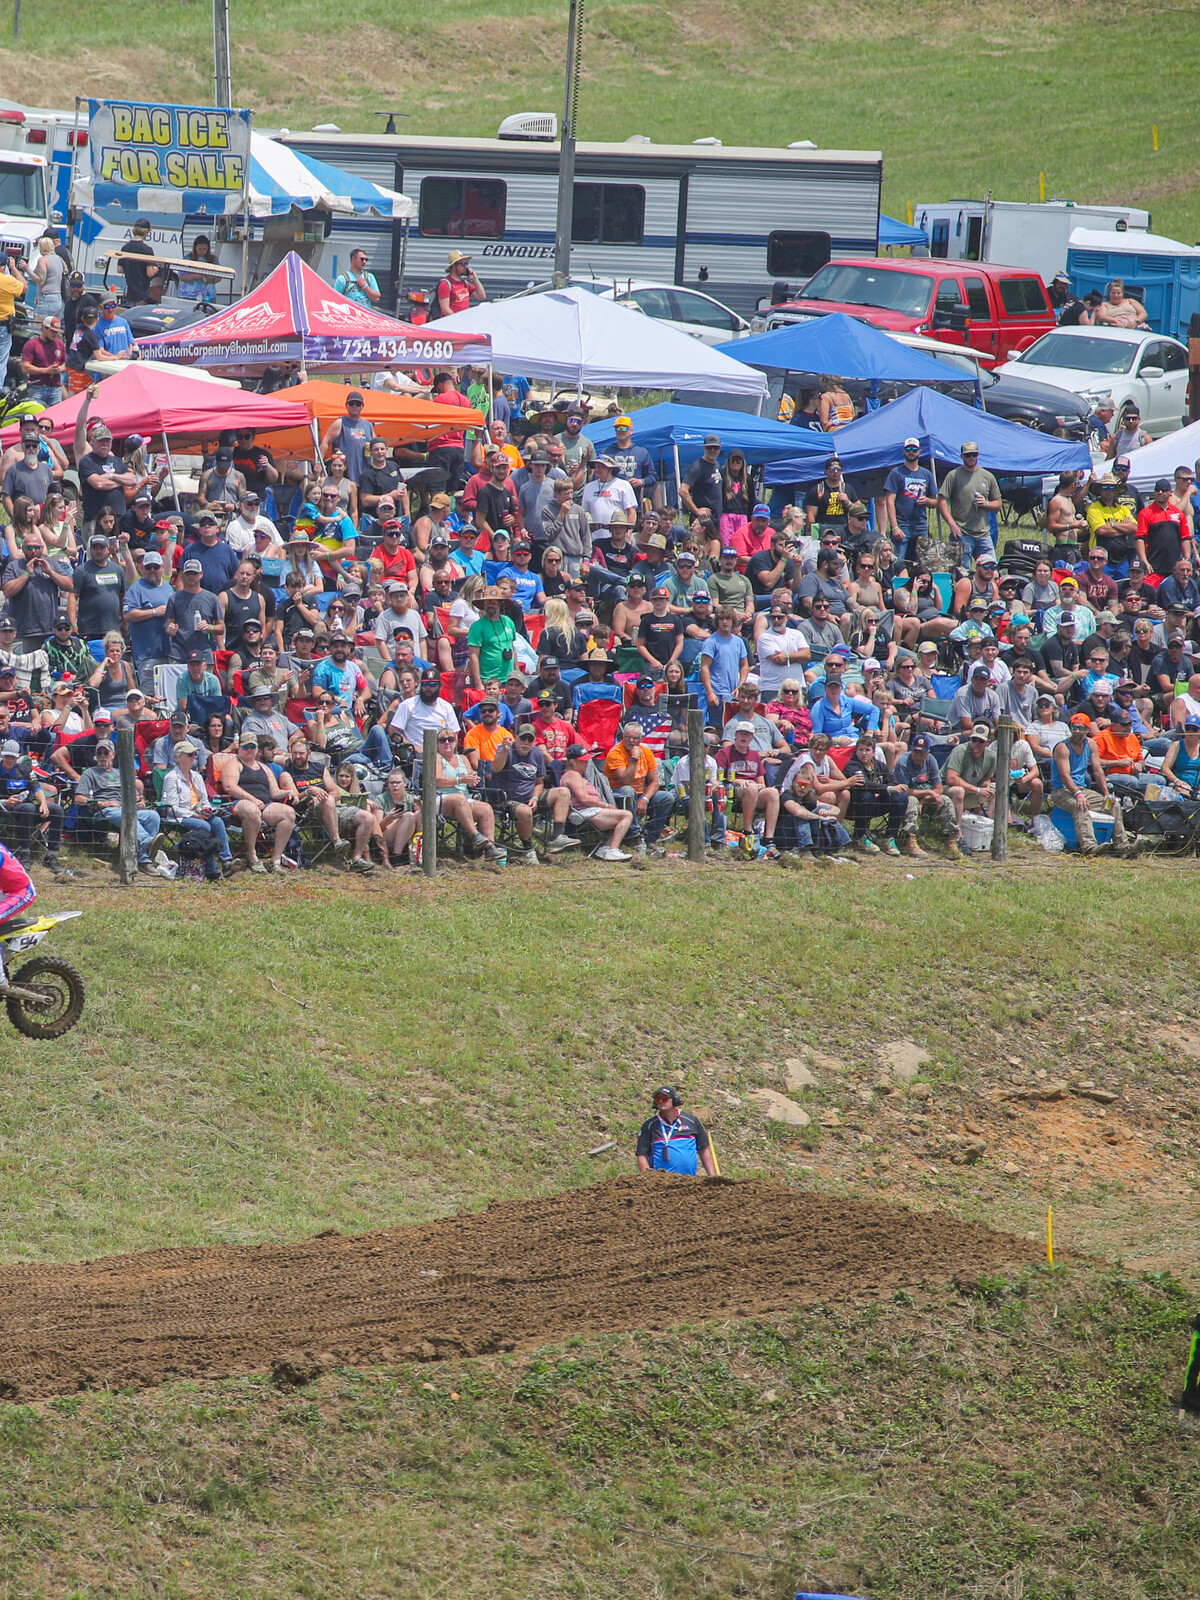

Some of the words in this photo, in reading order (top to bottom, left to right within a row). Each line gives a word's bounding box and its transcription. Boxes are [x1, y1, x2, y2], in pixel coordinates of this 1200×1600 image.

[112, 106, 172, 147] BAG
[178, 110, 230, 150] ICE
[102, 148, 162, 187] FOR
[167, 152, 245, 190] SALE
[342, 340, 454, 360] 724-434-9680
[20, 936, 38, 949] 94
